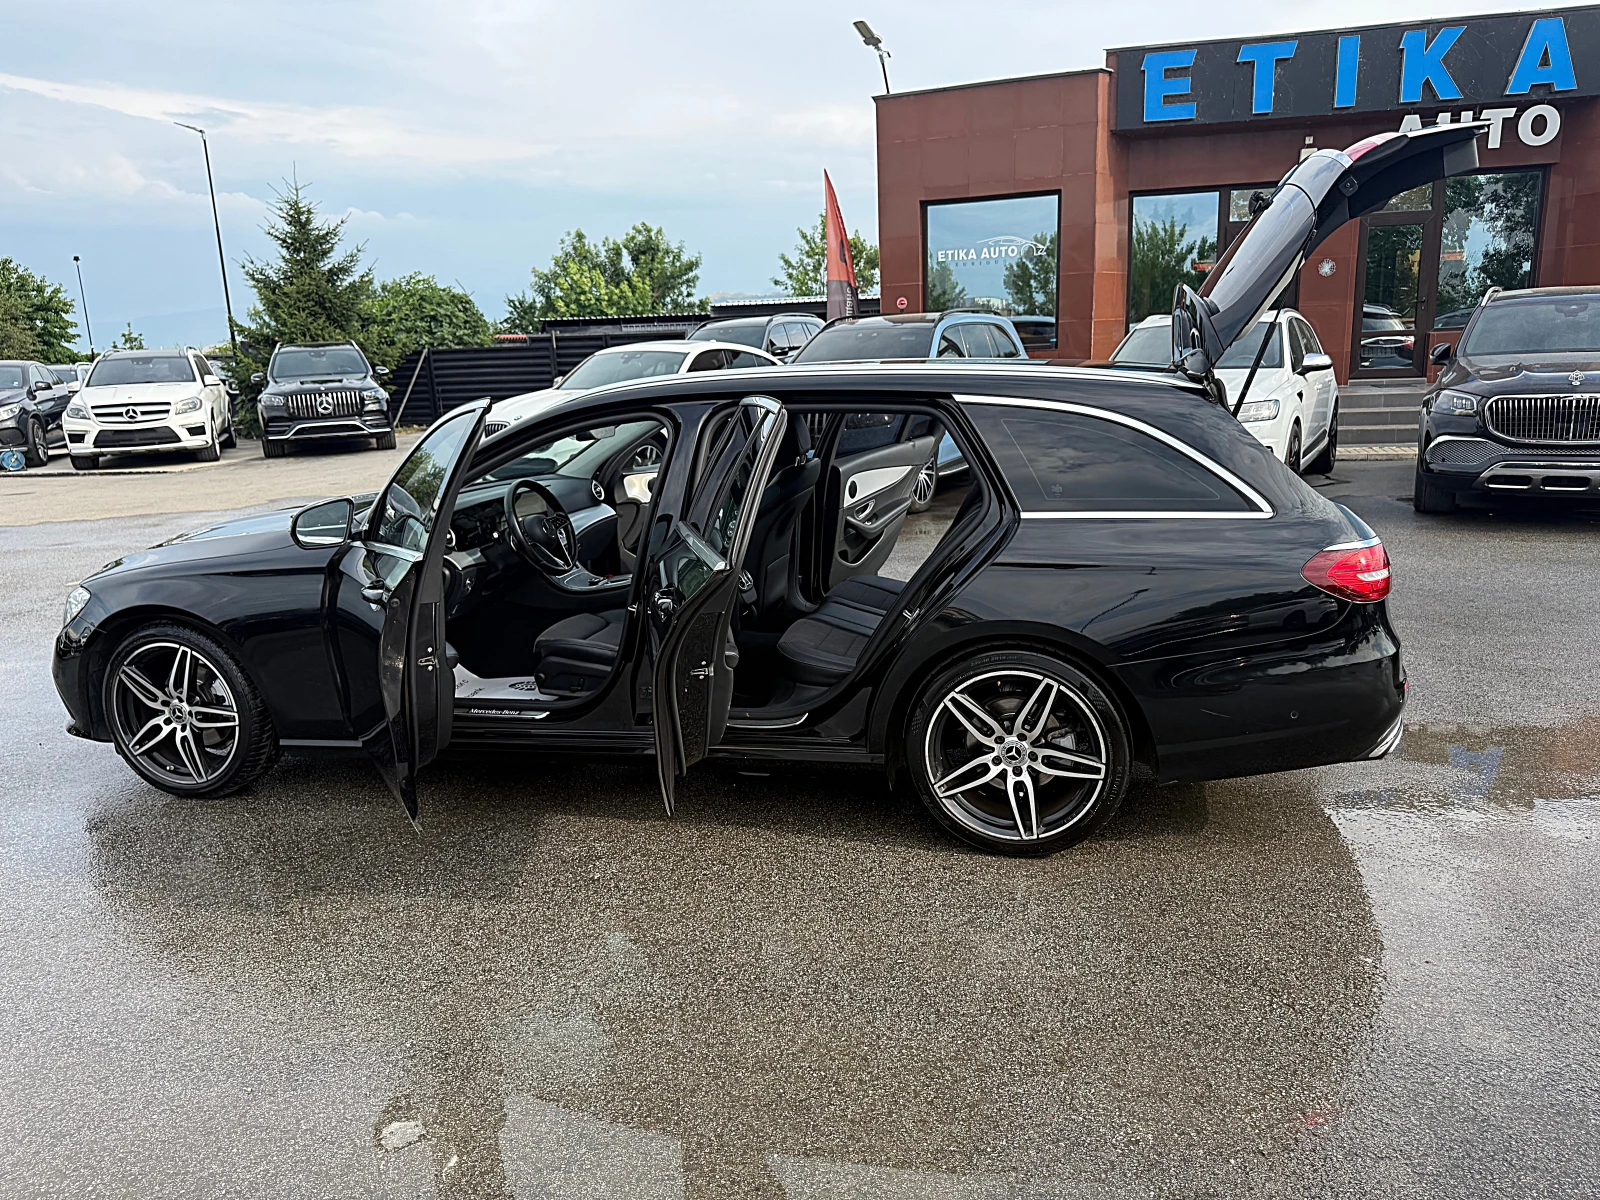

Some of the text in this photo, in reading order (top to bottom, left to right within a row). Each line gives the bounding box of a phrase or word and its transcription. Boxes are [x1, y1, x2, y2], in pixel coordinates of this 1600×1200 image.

[1141, 16, 1577, 122] ETIKA
[937, 245, 1018, 262] ETIKA AUTO
[938, 259, 1007, 268] UXURIOUS
